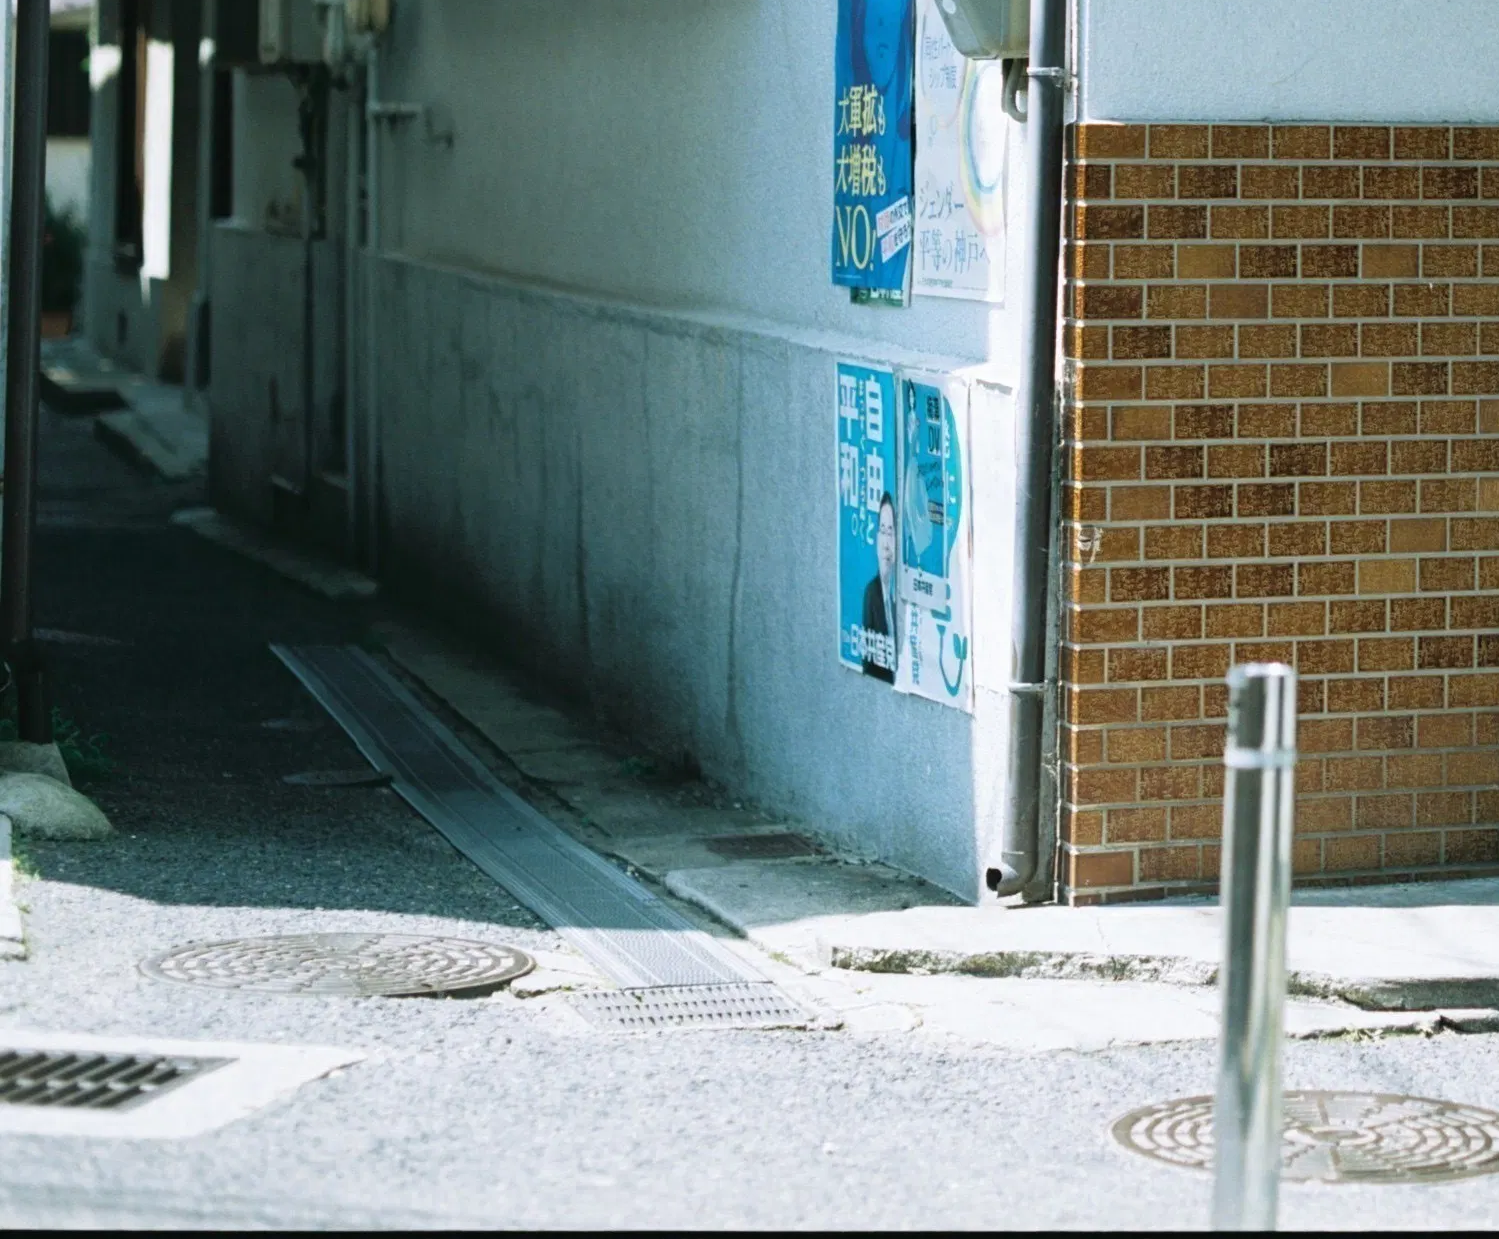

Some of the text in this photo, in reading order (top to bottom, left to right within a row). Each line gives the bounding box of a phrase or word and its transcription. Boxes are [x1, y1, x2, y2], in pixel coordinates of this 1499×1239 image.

[836, 83, 887, 137] 大軍拡も
[835, 144, 887, 196] 大増税も
[918, 180, 965, 221] ジェンダー
[835, 204, 877, 271] NO!
[919, 227, 991, 275] 平等の神戸へ
